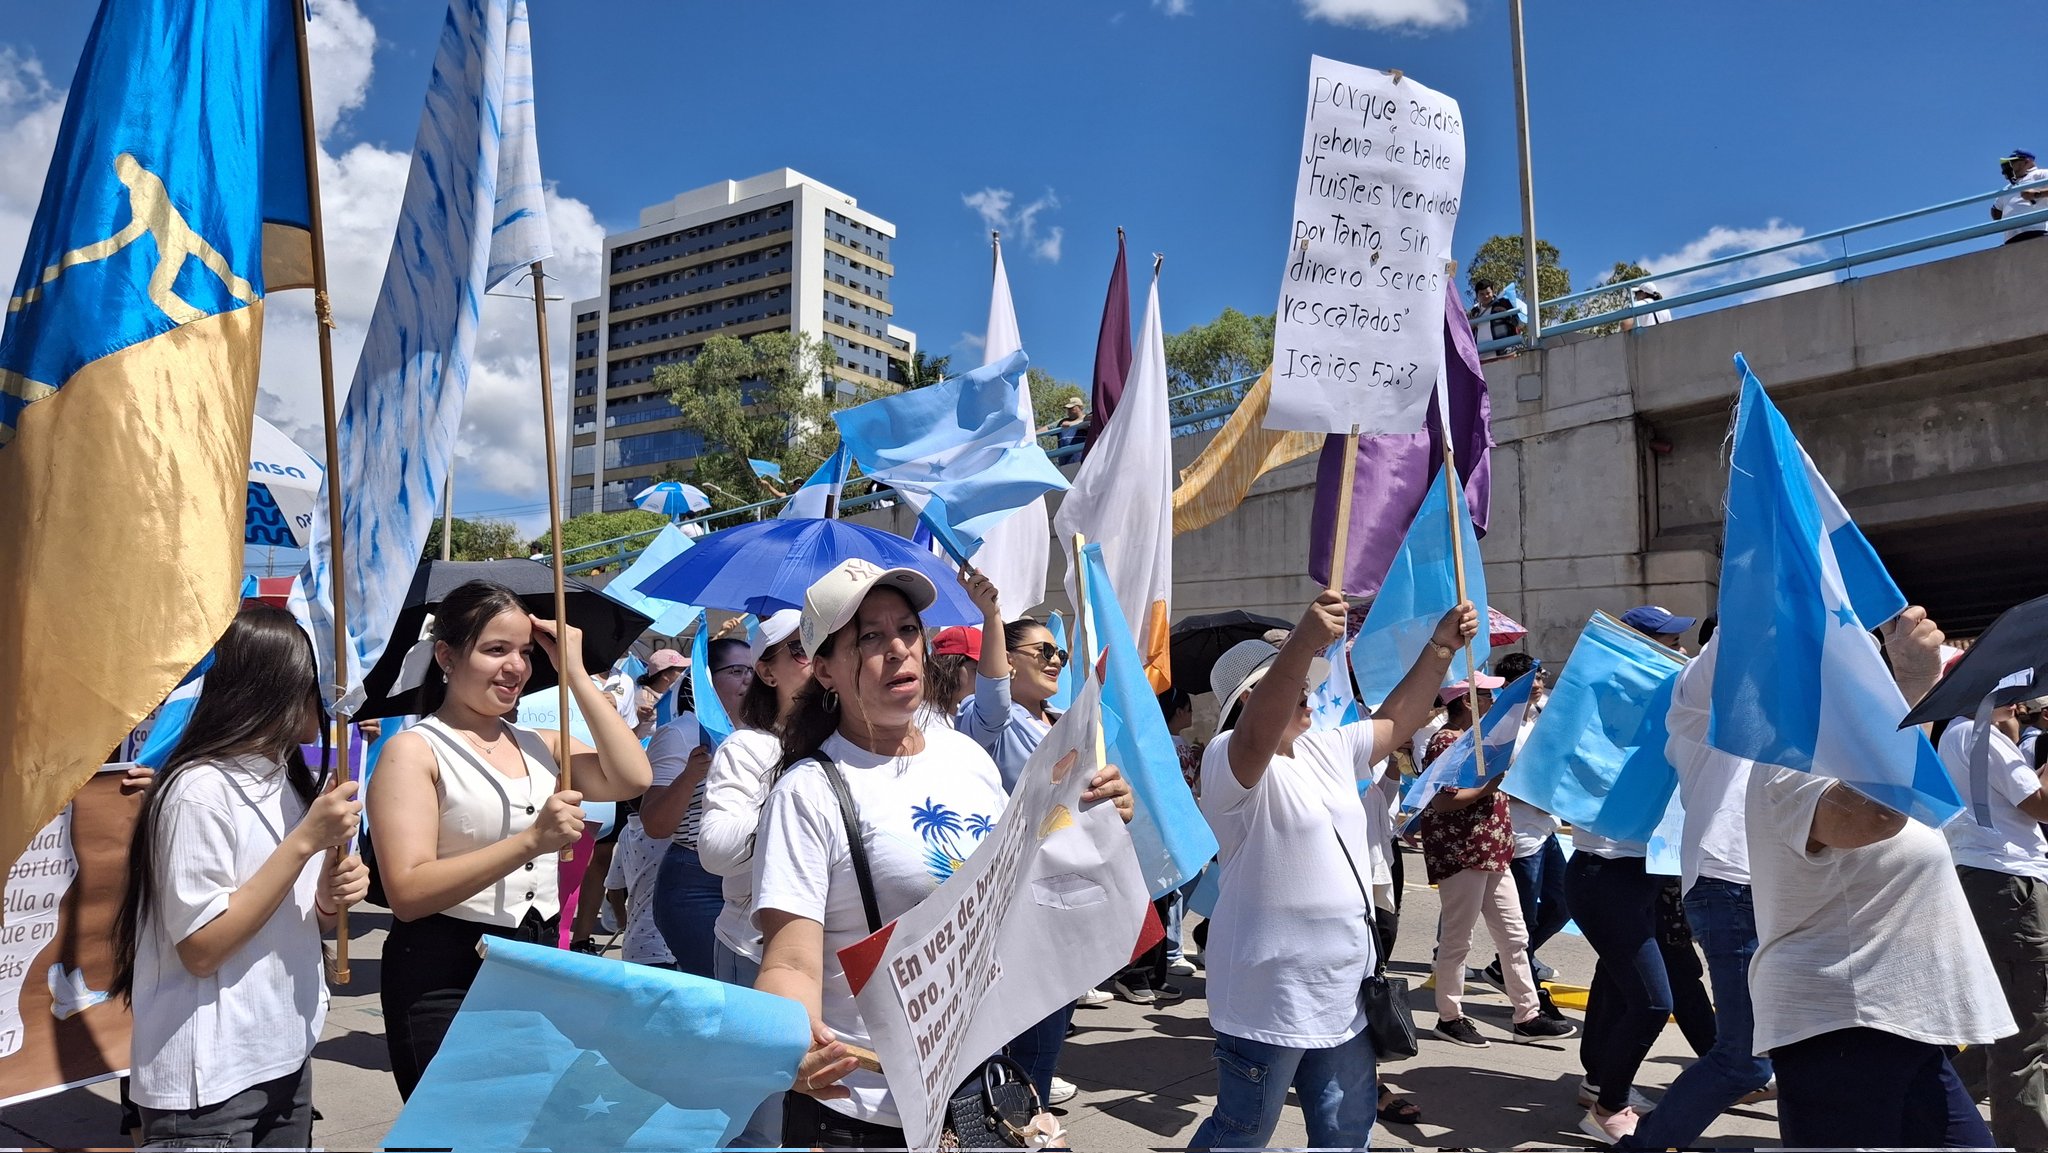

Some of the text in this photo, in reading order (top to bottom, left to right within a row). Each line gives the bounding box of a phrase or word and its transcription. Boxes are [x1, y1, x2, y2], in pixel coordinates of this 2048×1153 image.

[1413, 139, 1451, 170] balde
[1293, 220, 1325, 252] por
[1290, 251, 1363, 288] dinero
[1367, 361, 1418, 390] 52:3
[517, 707, 556, 722] chos
[26, 826, 63, 851] ual
[43, 892, 55, 909] a
[0, 921, 54, 944] ue en
[892, 953, 923, 990] En
[923, 920, 956, 965] vez
[957, 896, 975, 931] de
[907, 981, 945, 1023] oro,
[946, 956, 956, 988] y
